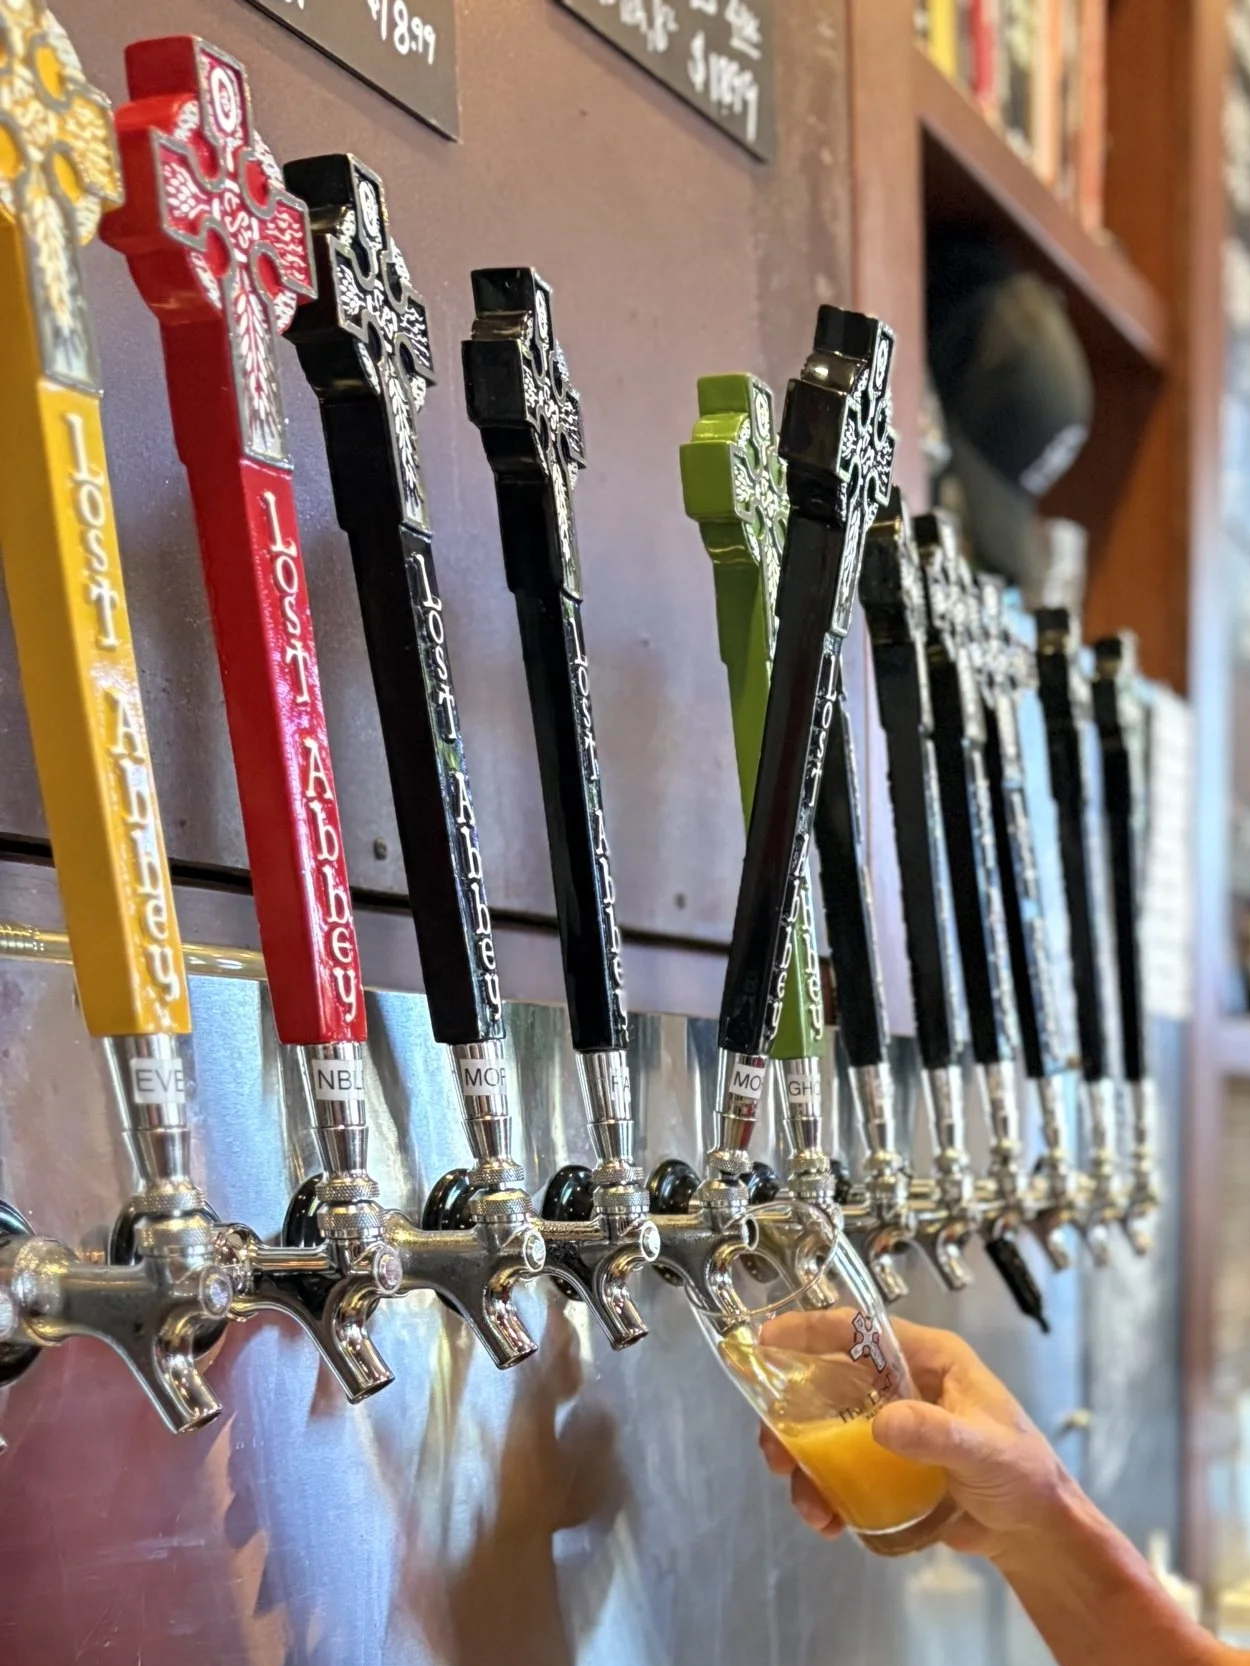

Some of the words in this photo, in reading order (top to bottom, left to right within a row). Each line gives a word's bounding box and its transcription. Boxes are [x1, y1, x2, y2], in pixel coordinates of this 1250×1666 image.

[304, 737, 358, 1022] Abbey
[453, 769, 501, 1020] Abbey
[800, 888, 824, 1041] bbey
